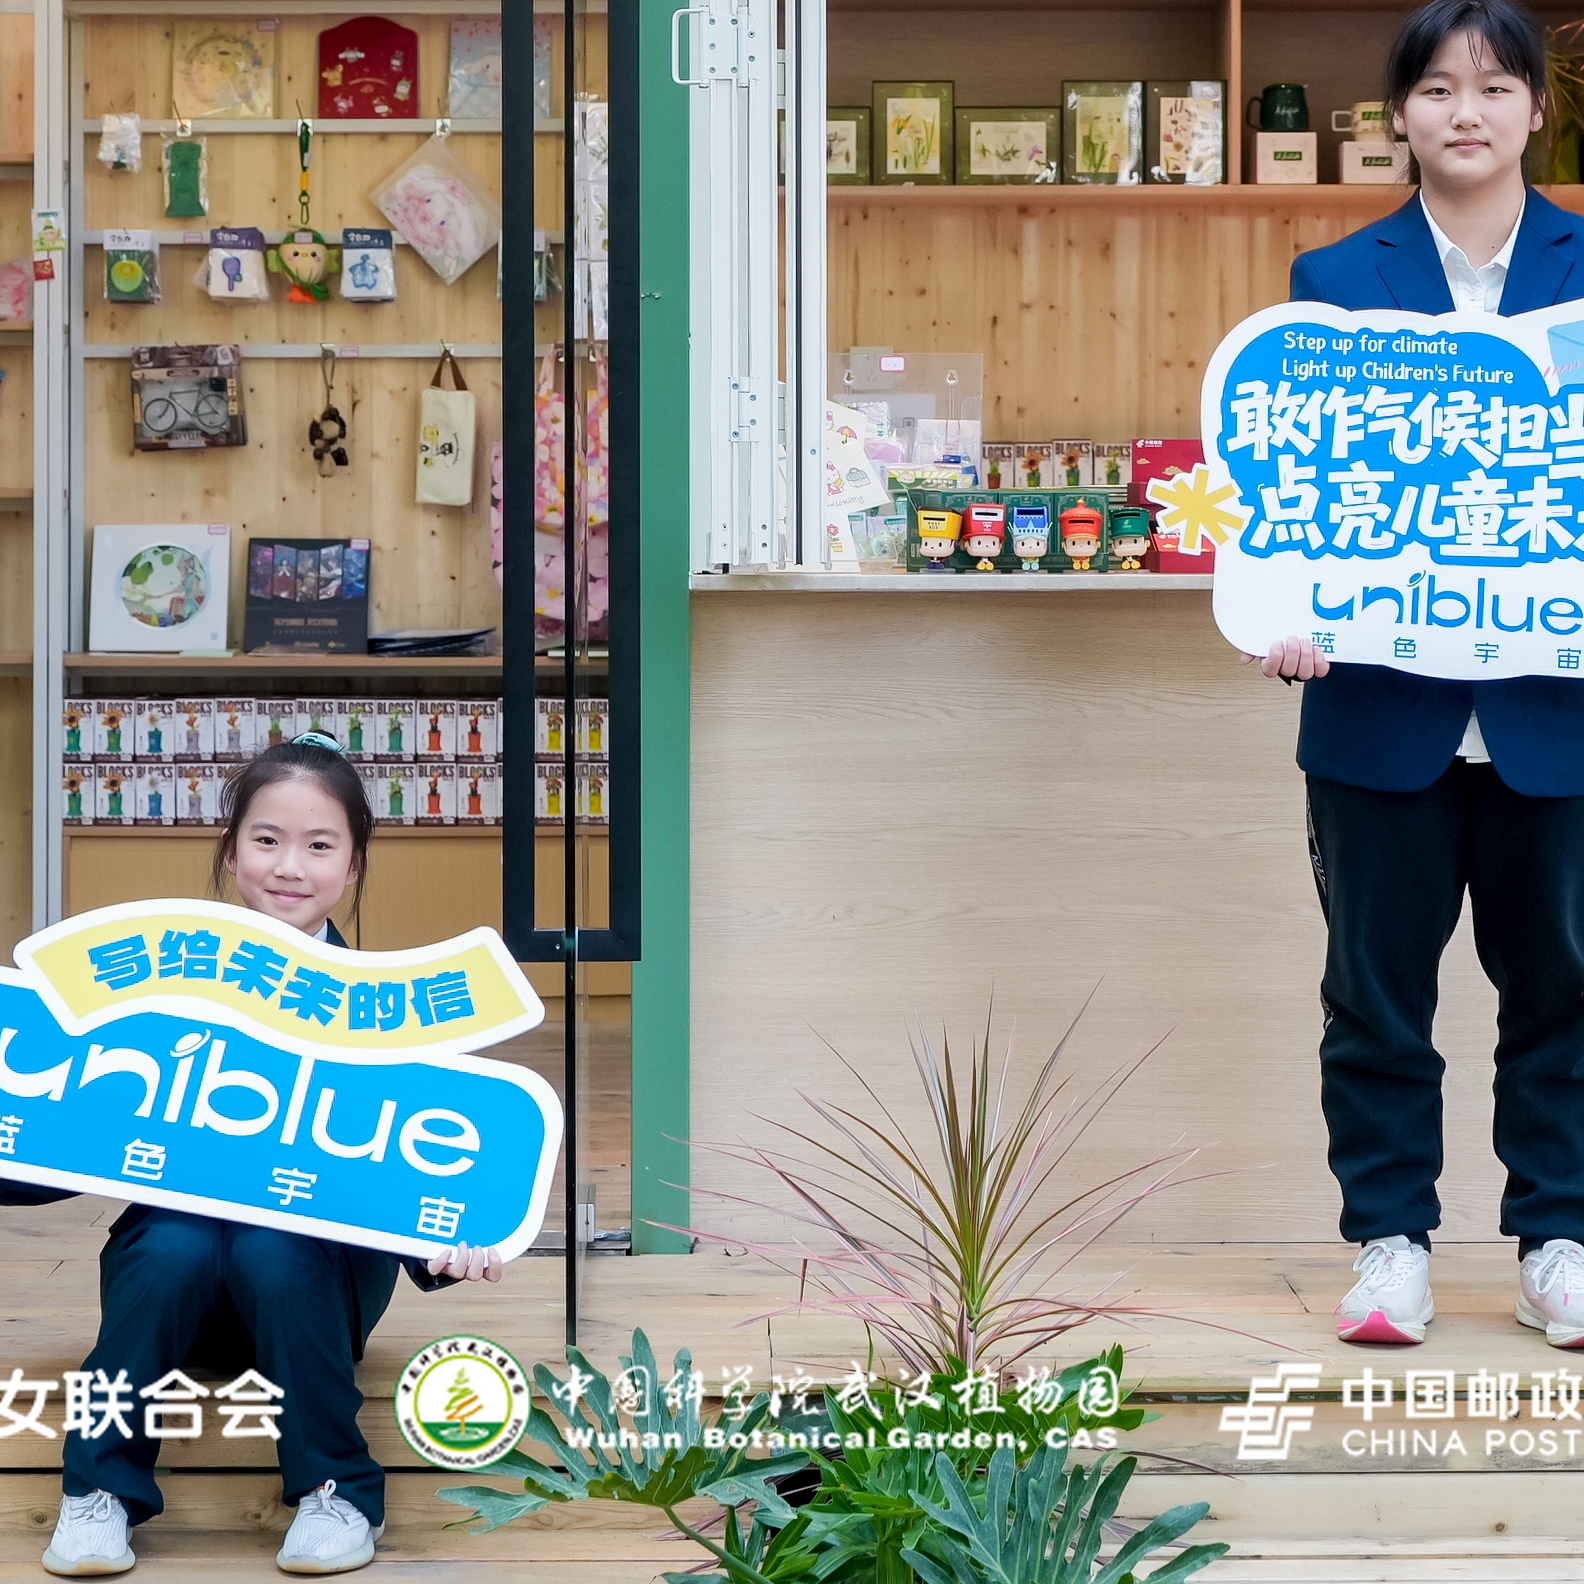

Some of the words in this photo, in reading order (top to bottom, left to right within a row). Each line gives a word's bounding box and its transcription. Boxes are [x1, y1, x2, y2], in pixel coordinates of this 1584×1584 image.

[1284, 331, 1327, 356] Step
[1332, 337, 1355, 356] up
[1359, 333, 1387, 354] for
[1392, 333, 1459, 356] climate
[1282, 359, 1329, 381] Light
[1335, 364, 1357, 382] up
[1362, 360, 1448, 383] Children's
[1453, 365, 1514, 385] Future
[1312, 569, 1584, 635] uniblue
[1311, 631, 1582, 671] 蓝色宇宙
[87, 929, 476, 1032] 写给未来的信
